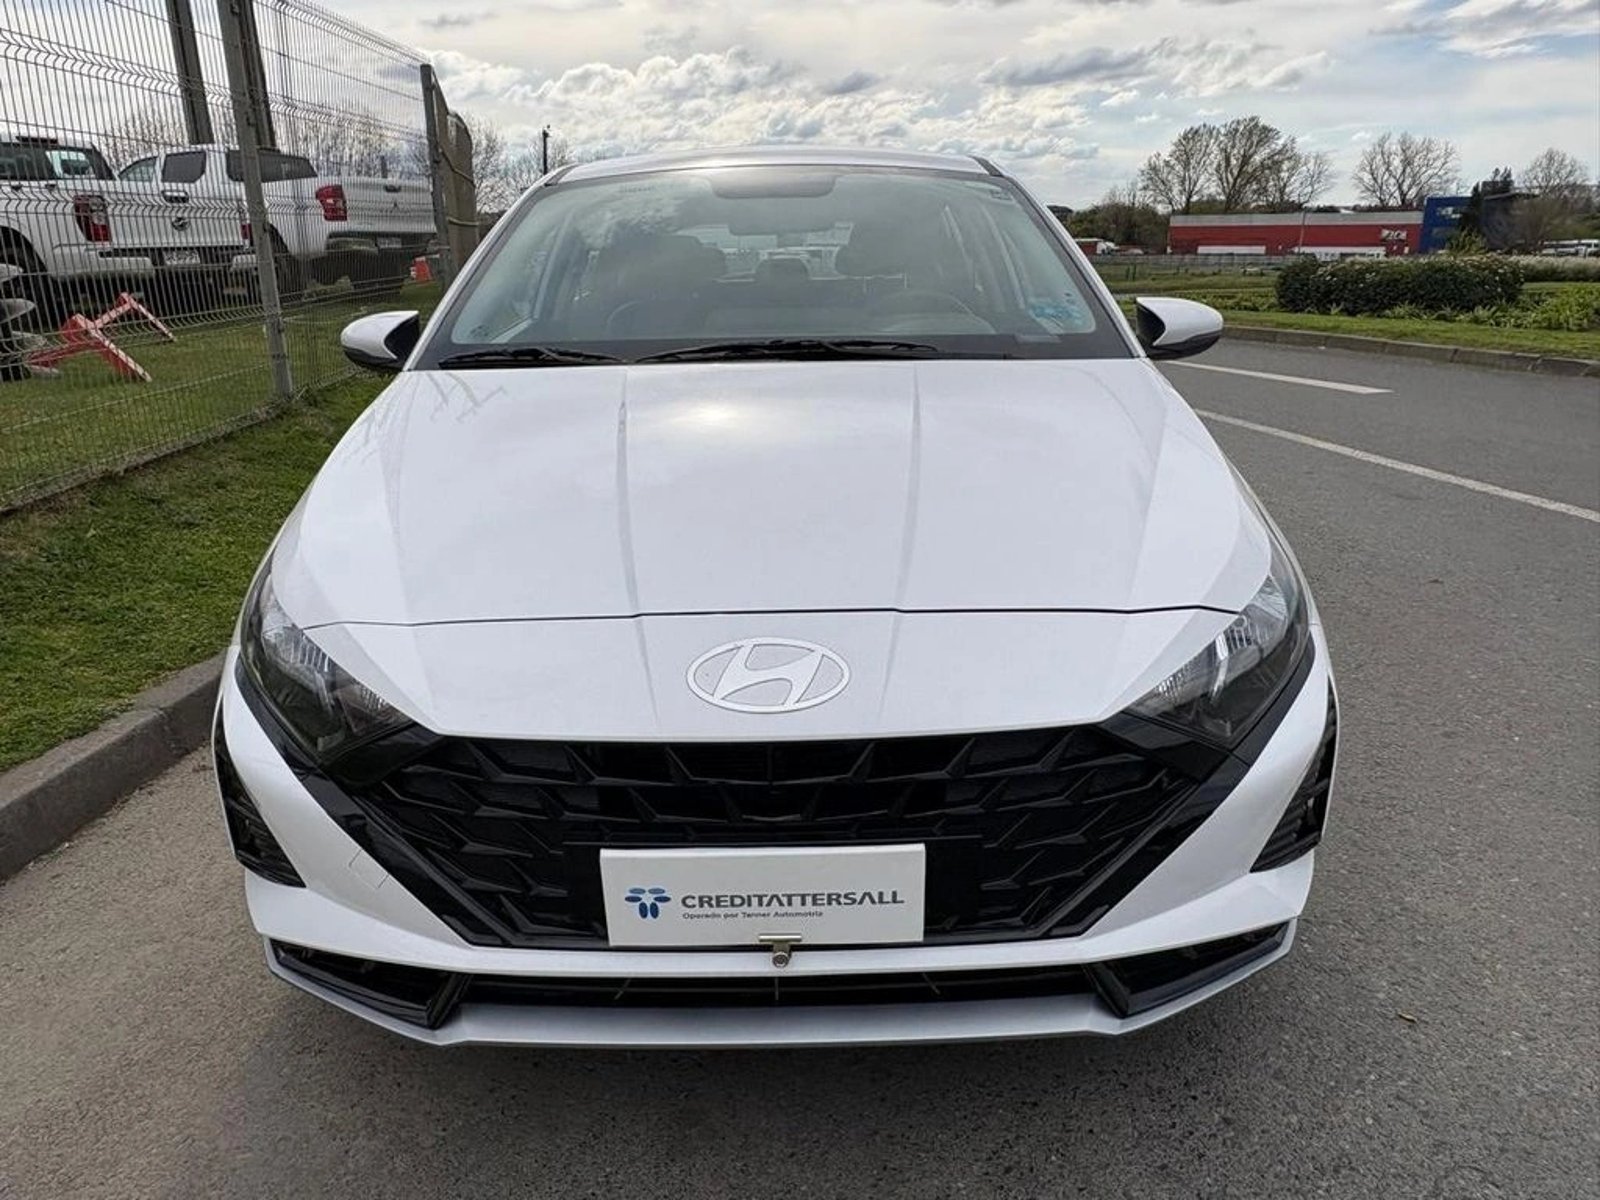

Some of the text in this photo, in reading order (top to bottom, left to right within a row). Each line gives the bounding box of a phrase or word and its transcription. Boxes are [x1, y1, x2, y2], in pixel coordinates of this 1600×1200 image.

[681, 890, 905, 909] CREDITATTERSALL
[682, 911, 721, 920] Operado
[723, 912, 739, 920] por
